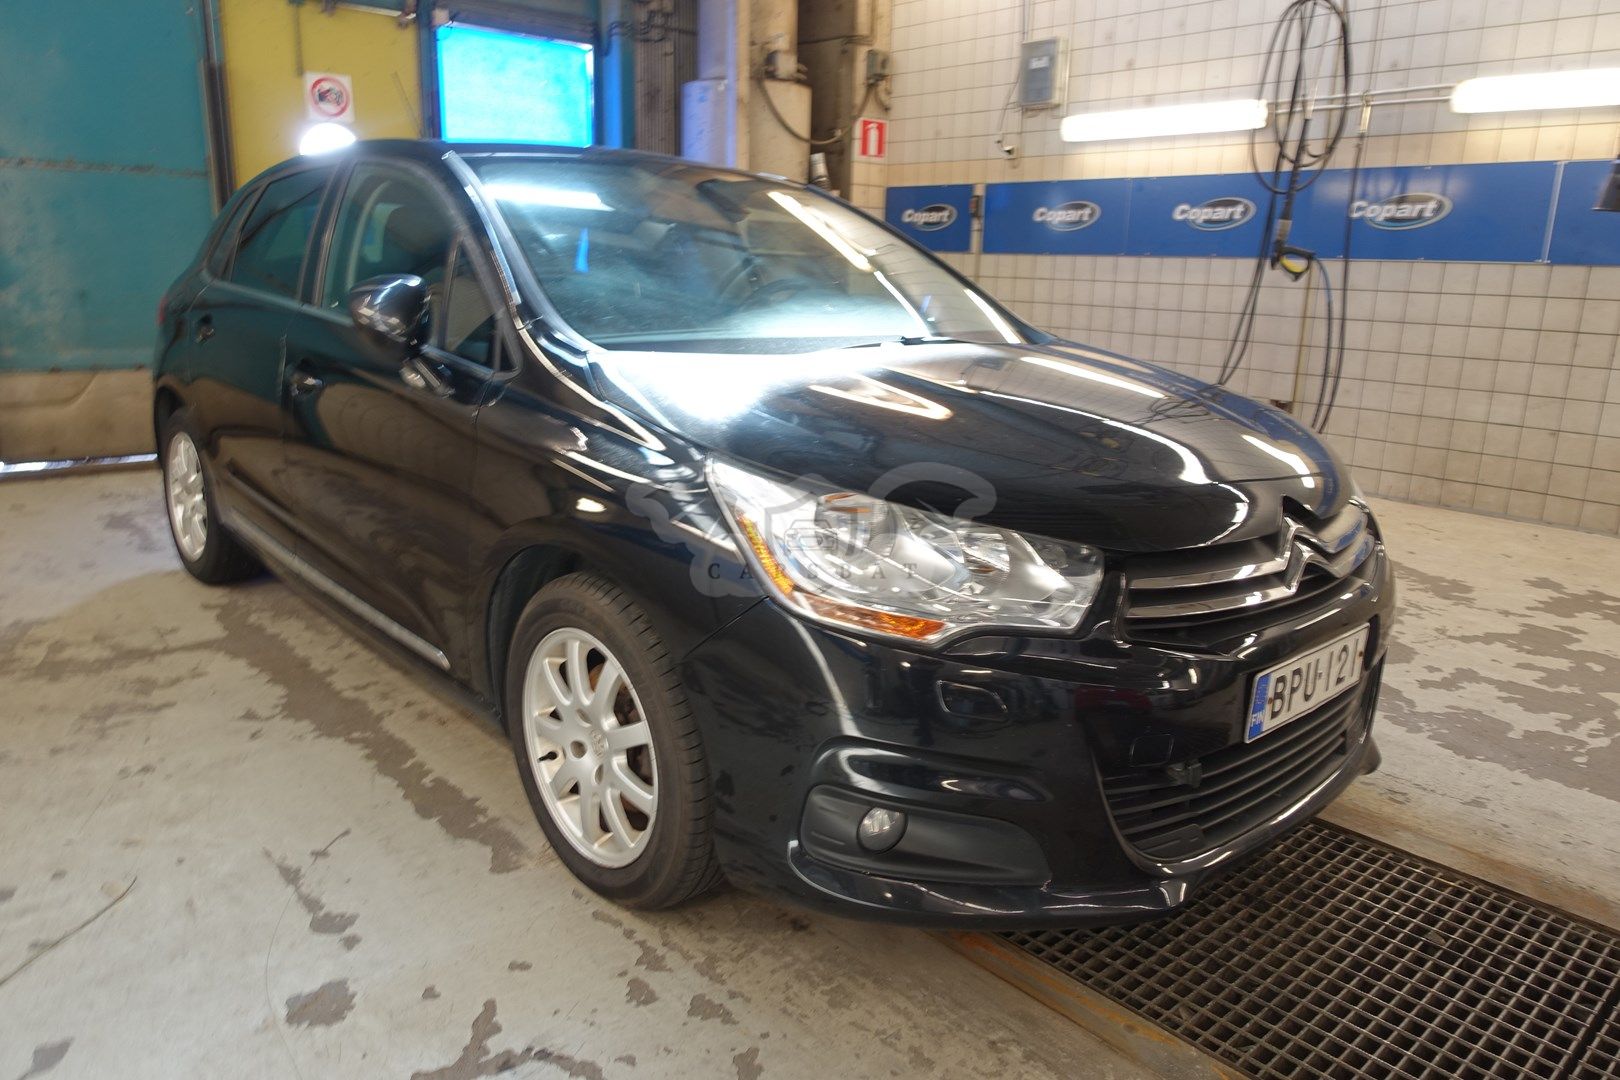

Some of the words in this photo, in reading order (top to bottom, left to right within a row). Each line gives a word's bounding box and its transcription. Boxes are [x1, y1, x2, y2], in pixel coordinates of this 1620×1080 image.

[902, 209, 951, 225] Copart
[1032, 206, 1094, 225] Copart
[1172, 203, 1247, 223] Copart
[1350, 199, 1438, 221] Copart
[1271, 638, 1360, 720] BPU-121
